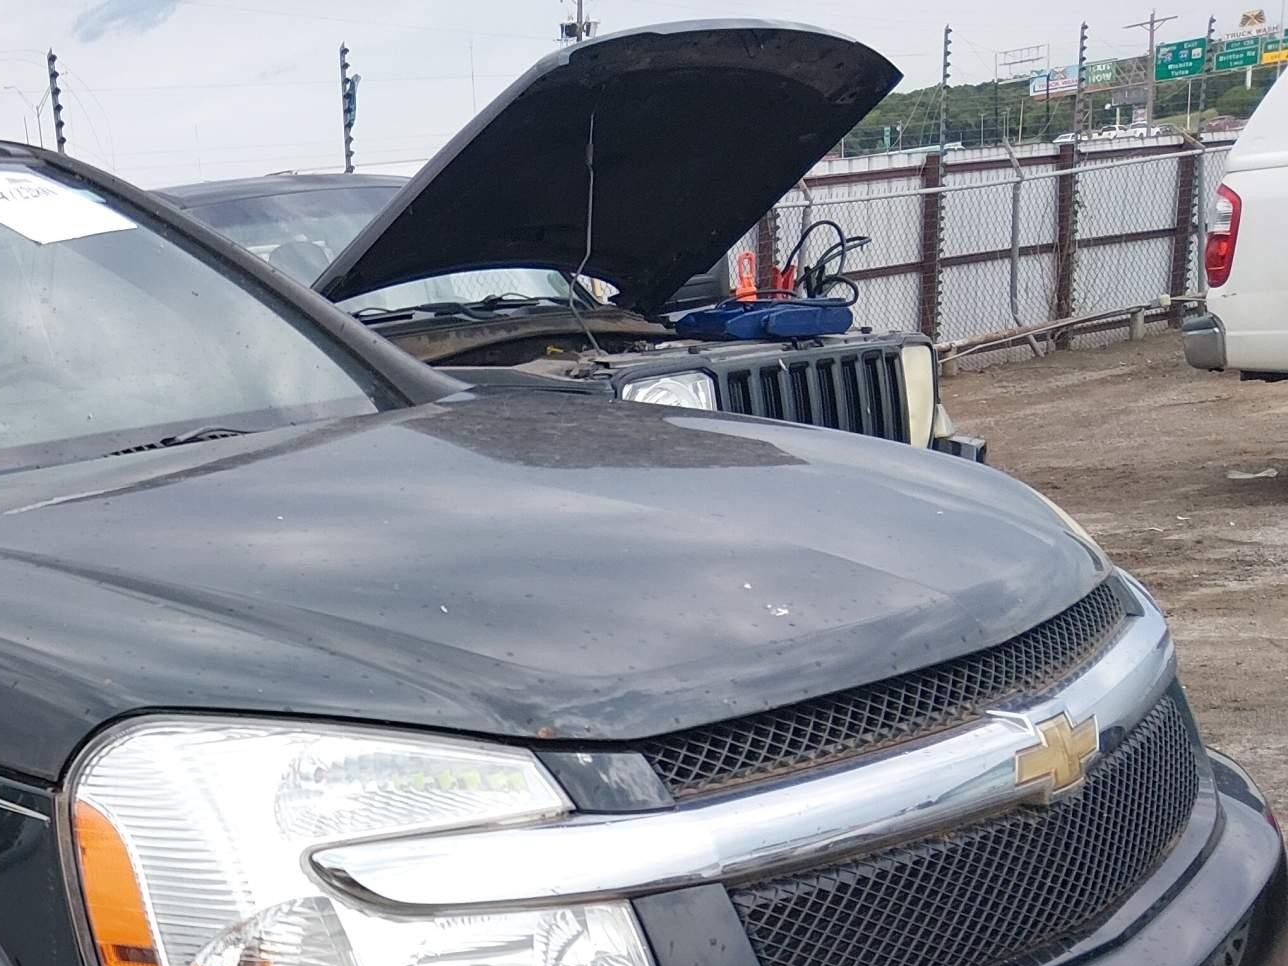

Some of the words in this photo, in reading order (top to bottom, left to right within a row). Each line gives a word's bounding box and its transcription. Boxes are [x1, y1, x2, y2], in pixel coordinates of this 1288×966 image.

[1225, 31, 1253, 39] TRUCK
[1255, 24, 1280, 35] WASH
[1168, 62, 1193, 70] Wichita
